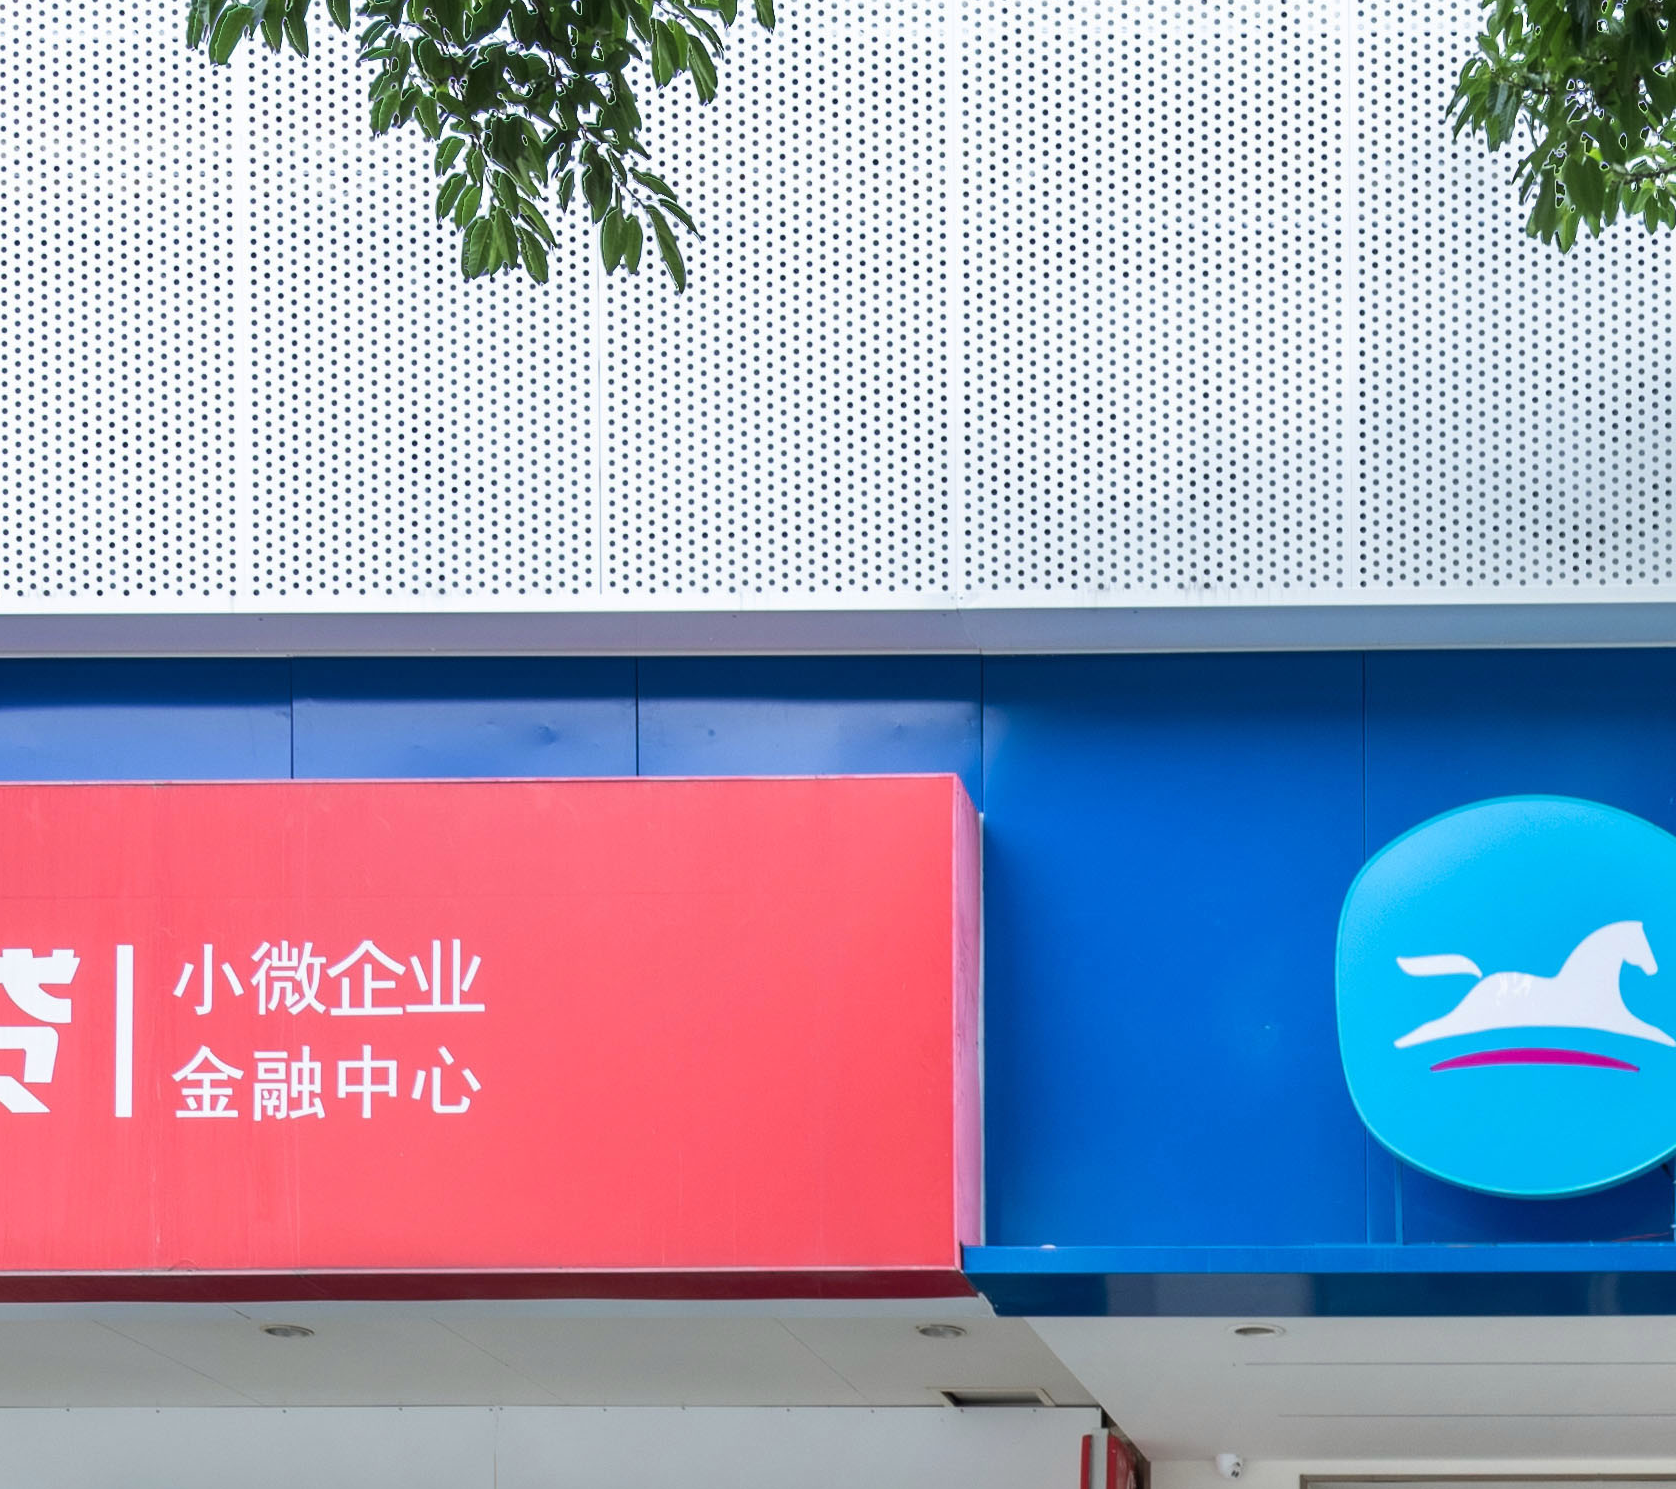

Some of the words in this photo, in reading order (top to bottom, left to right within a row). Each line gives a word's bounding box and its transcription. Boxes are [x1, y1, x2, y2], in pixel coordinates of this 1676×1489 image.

[172, 939, 486, 1017] 小微企业
[172, 1044, 482, 1122] 金融中心
